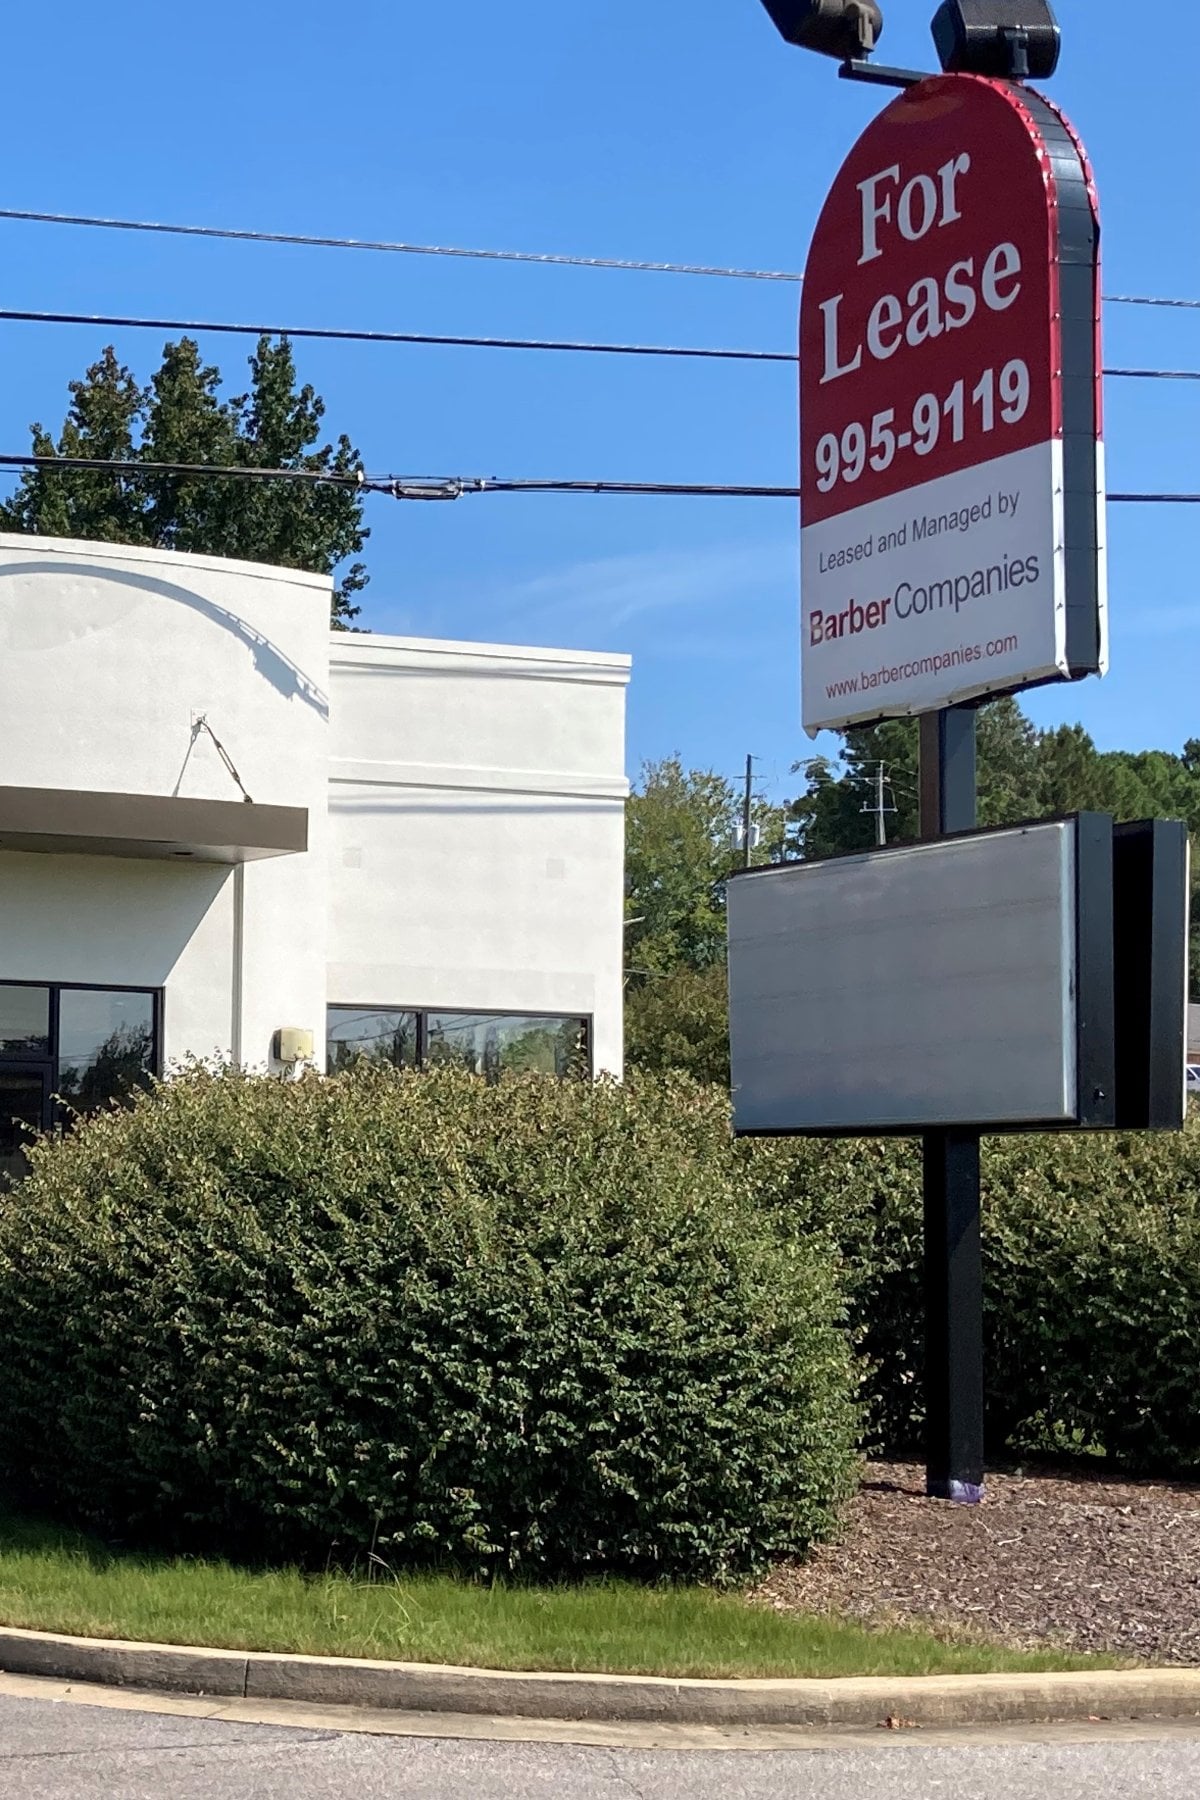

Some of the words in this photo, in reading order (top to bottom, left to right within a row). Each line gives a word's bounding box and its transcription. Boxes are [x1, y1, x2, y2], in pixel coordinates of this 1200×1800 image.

[856, 152, 970, 266] For
[819, 242, 1022, 385] Lease
[815, 358, 1030, 493] 995-9119
[819, 535, 873, 573] Leased
[877, 523, 907, 553] and
[912, 499, 992, 542] Managed
[998, 491, 1020, 517] by
[825, 634, 1018, 699] www.barbercompanies.com
